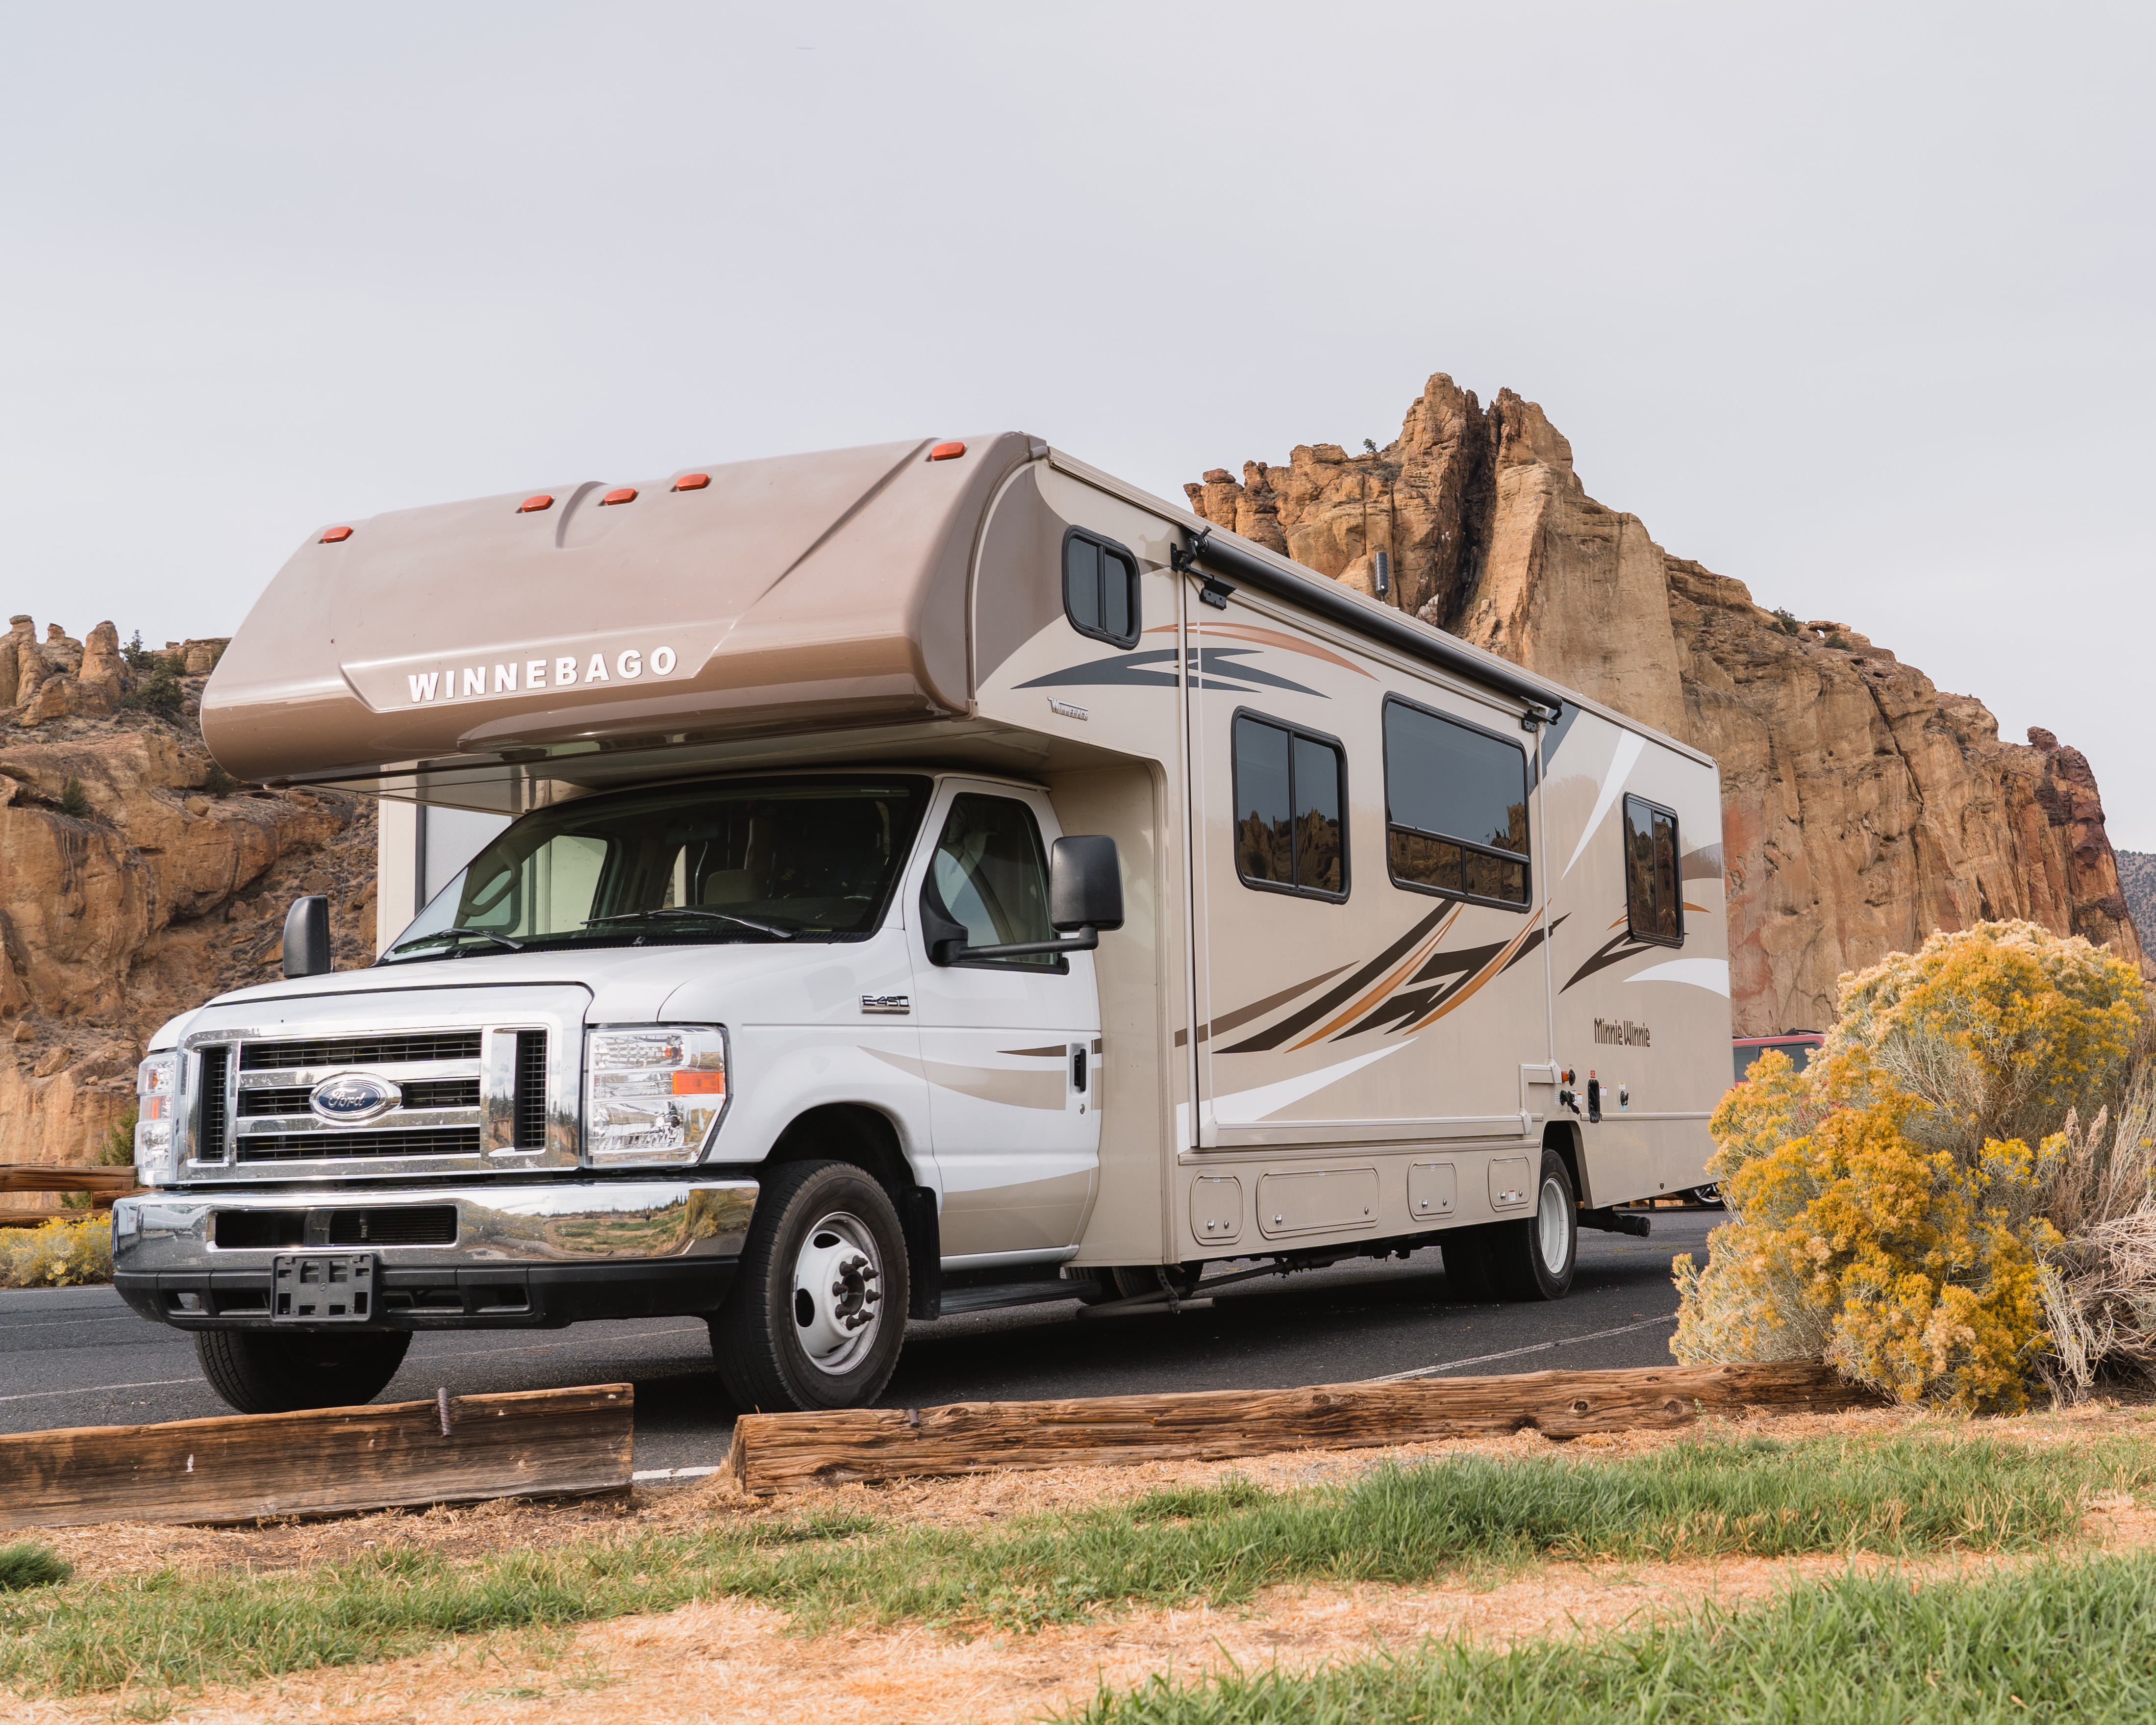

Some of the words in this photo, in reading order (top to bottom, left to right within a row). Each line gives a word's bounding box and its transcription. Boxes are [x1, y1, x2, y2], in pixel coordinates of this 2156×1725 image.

[408, 646, 677, 703] WINNEBAGO
[1047, 696, 1089, 721] WINNEBAGO
[861, 995, 909, 1007] E-450
[1594, 1017, 1623, 1045] Minnie
[1623, 1020, 1651, 1047] Winnie
[327, 1087, 367, 1109] Ford
